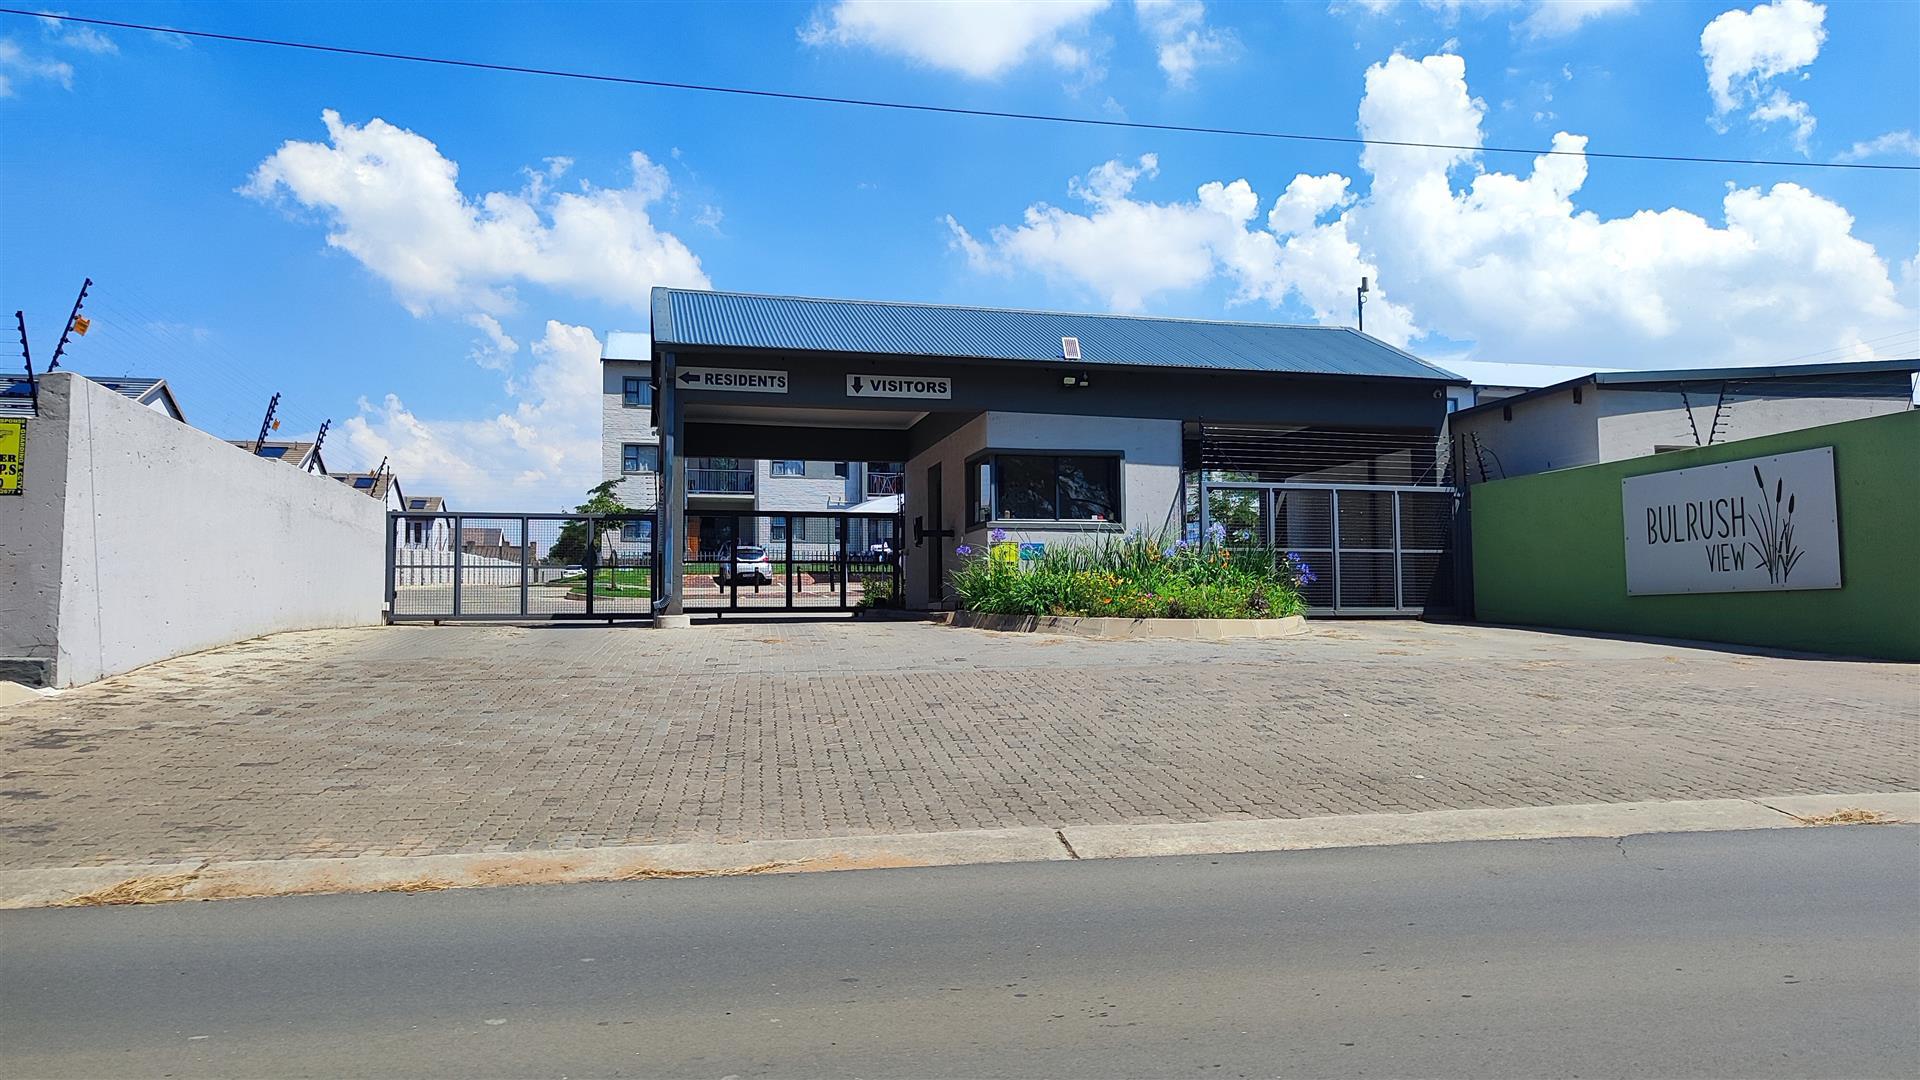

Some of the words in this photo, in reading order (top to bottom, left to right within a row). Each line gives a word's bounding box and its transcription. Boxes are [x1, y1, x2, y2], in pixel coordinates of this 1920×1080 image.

[704, 373, 786, 388] RESIDENTS
[870, 379, 948, 394] VISITORS
[1646, 496, 1746, 544] BULRUSH
[1706, 542, 1746, 572] VIEW
